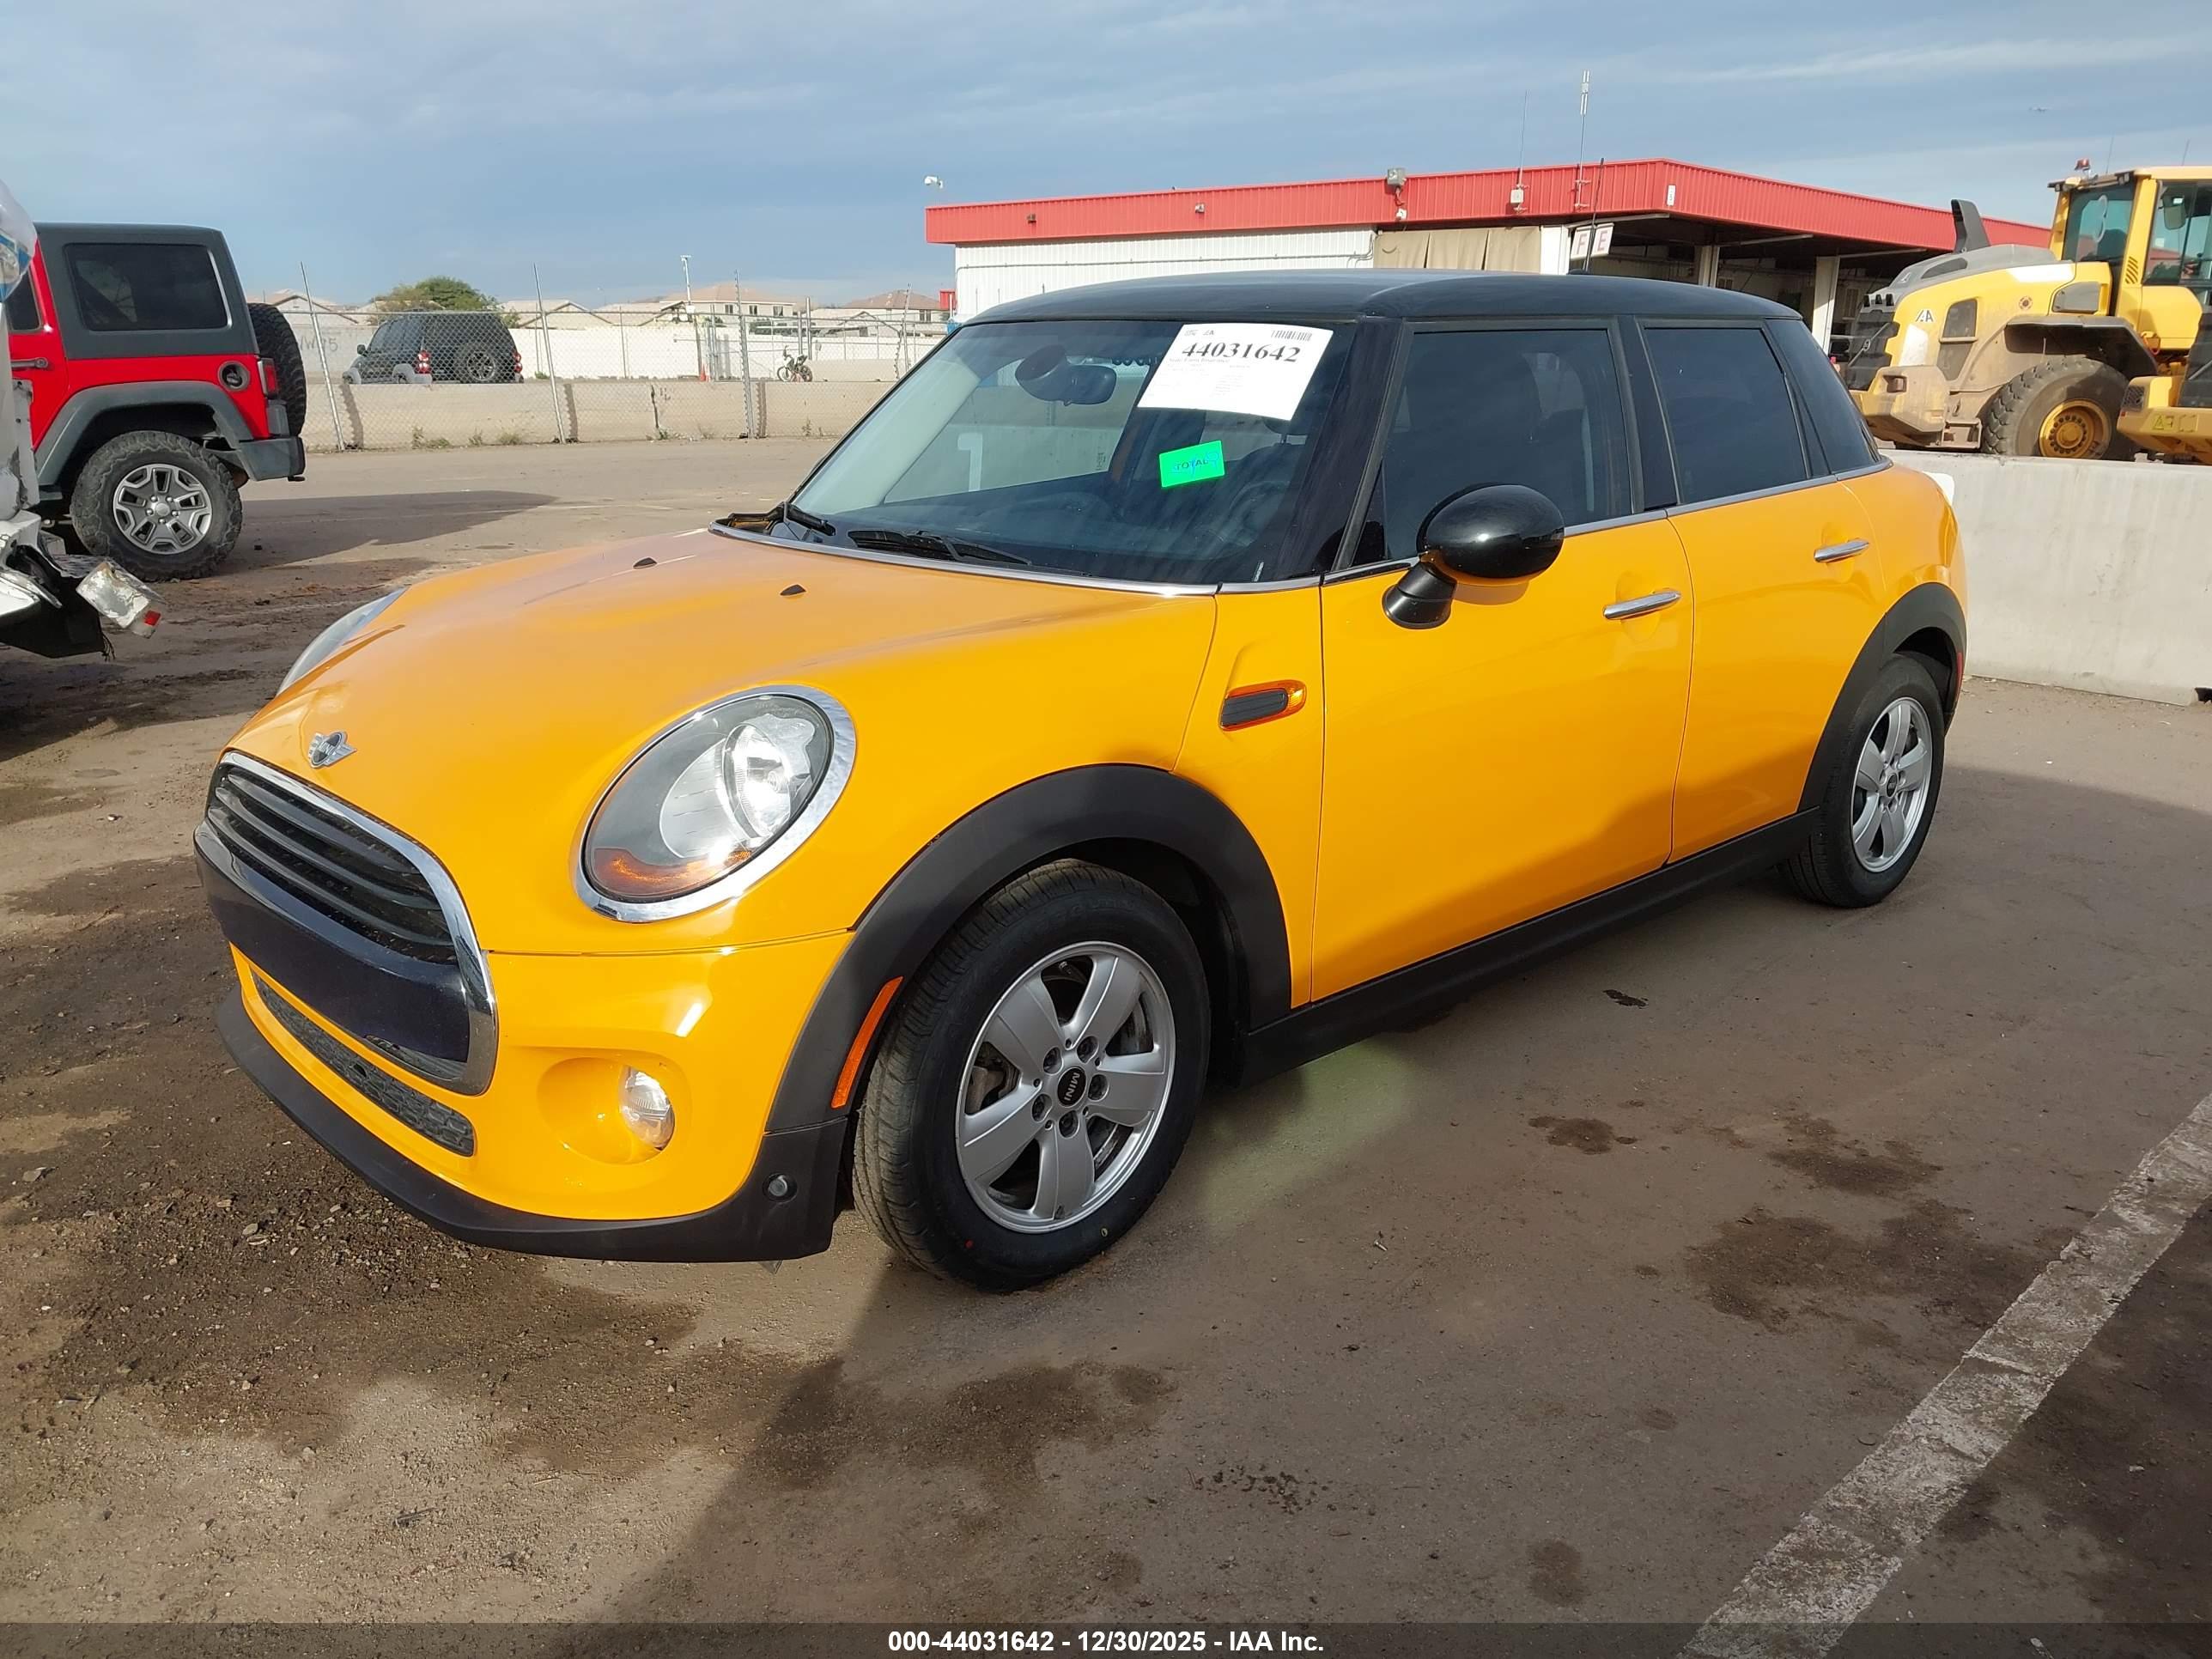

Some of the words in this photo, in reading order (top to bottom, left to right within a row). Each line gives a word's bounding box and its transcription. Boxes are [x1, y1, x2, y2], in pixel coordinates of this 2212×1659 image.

[1597, 230, 1608, 252] E
[1182, 342, 1301, 362] 44031642
[1176, 459, 1209, 471] TOTAL
[1064, 1072, 1080, 1102] MINI
